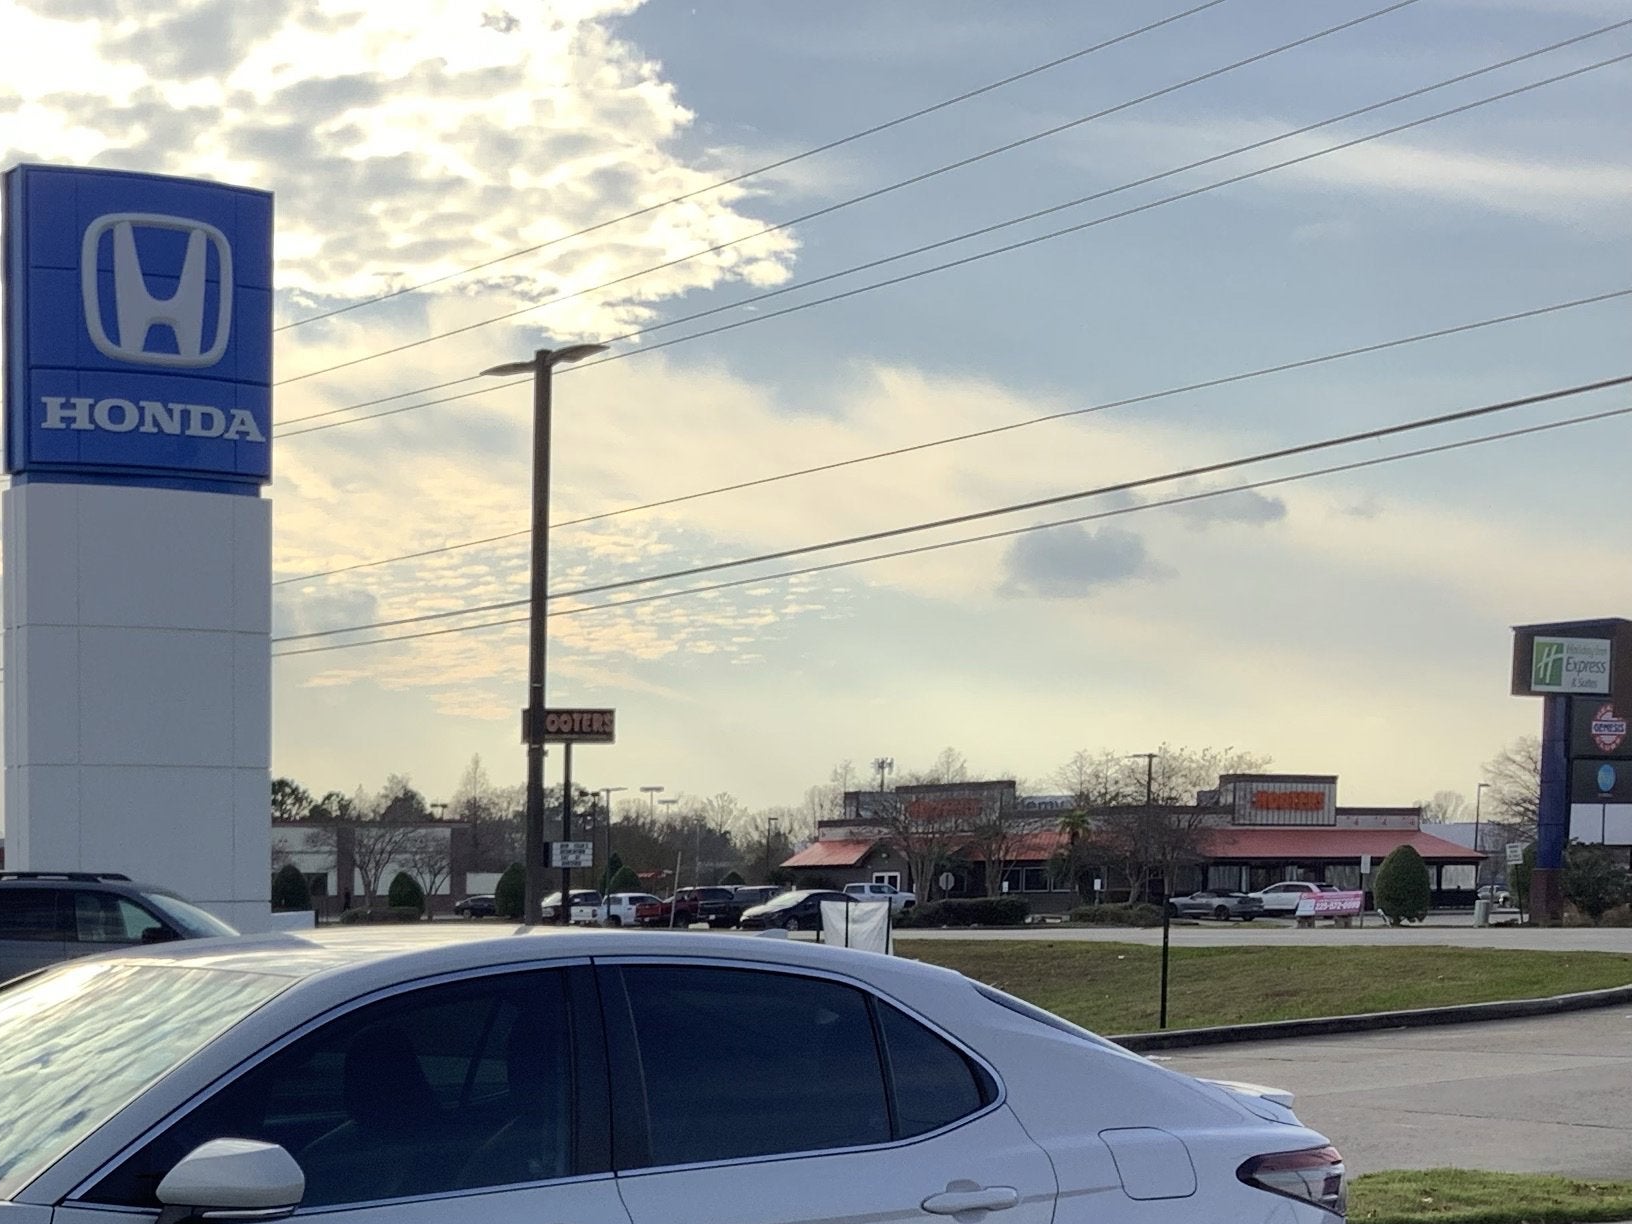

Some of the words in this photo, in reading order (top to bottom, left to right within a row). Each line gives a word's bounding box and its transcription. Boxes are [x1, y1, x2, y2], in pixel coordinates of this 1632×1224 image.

[40, 396, 266, 442] HONDA
[1565, 656, 1607, 677] Express
[545, 712, 614, 733] OOTERS
[1593, 723, 1625, 733] GENESIS
